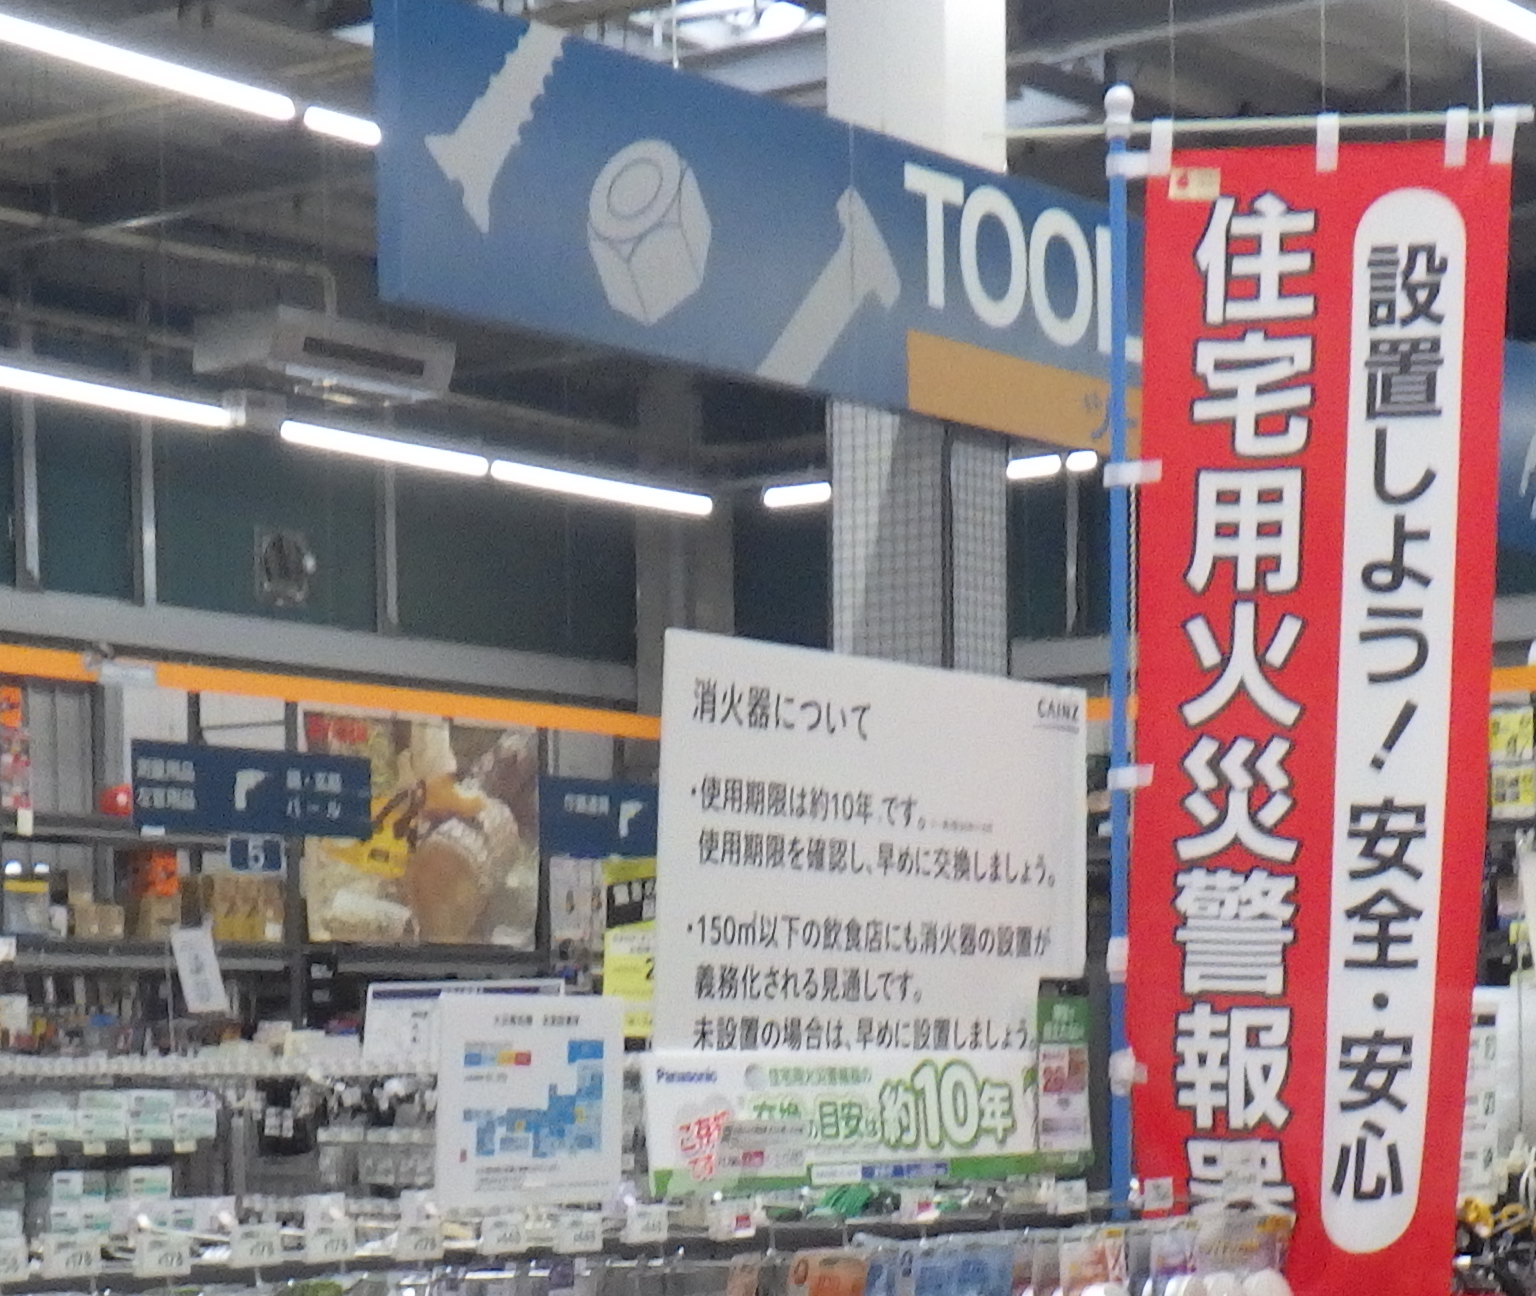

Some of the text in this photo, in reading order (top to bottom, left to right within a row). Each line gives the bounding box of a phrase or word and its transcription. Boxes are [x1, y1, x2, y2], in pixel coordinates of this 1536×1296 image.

[692, 676, 871, 741] 消火器について
[1037, 698, 1080, 721] CAINZ
[698, 828, 1056, 888] 使用期限を確認し、早めに交換しましょう。
[694, 963, 922, 1004] 義務化される見通しです。
[692, 1015, 1036, 1052] 未設置の場合は、早めに設置しましょう。
[655, 1066, 718, 1084] Panasonic
[879, 1058, 1017, 1149] 約10年
